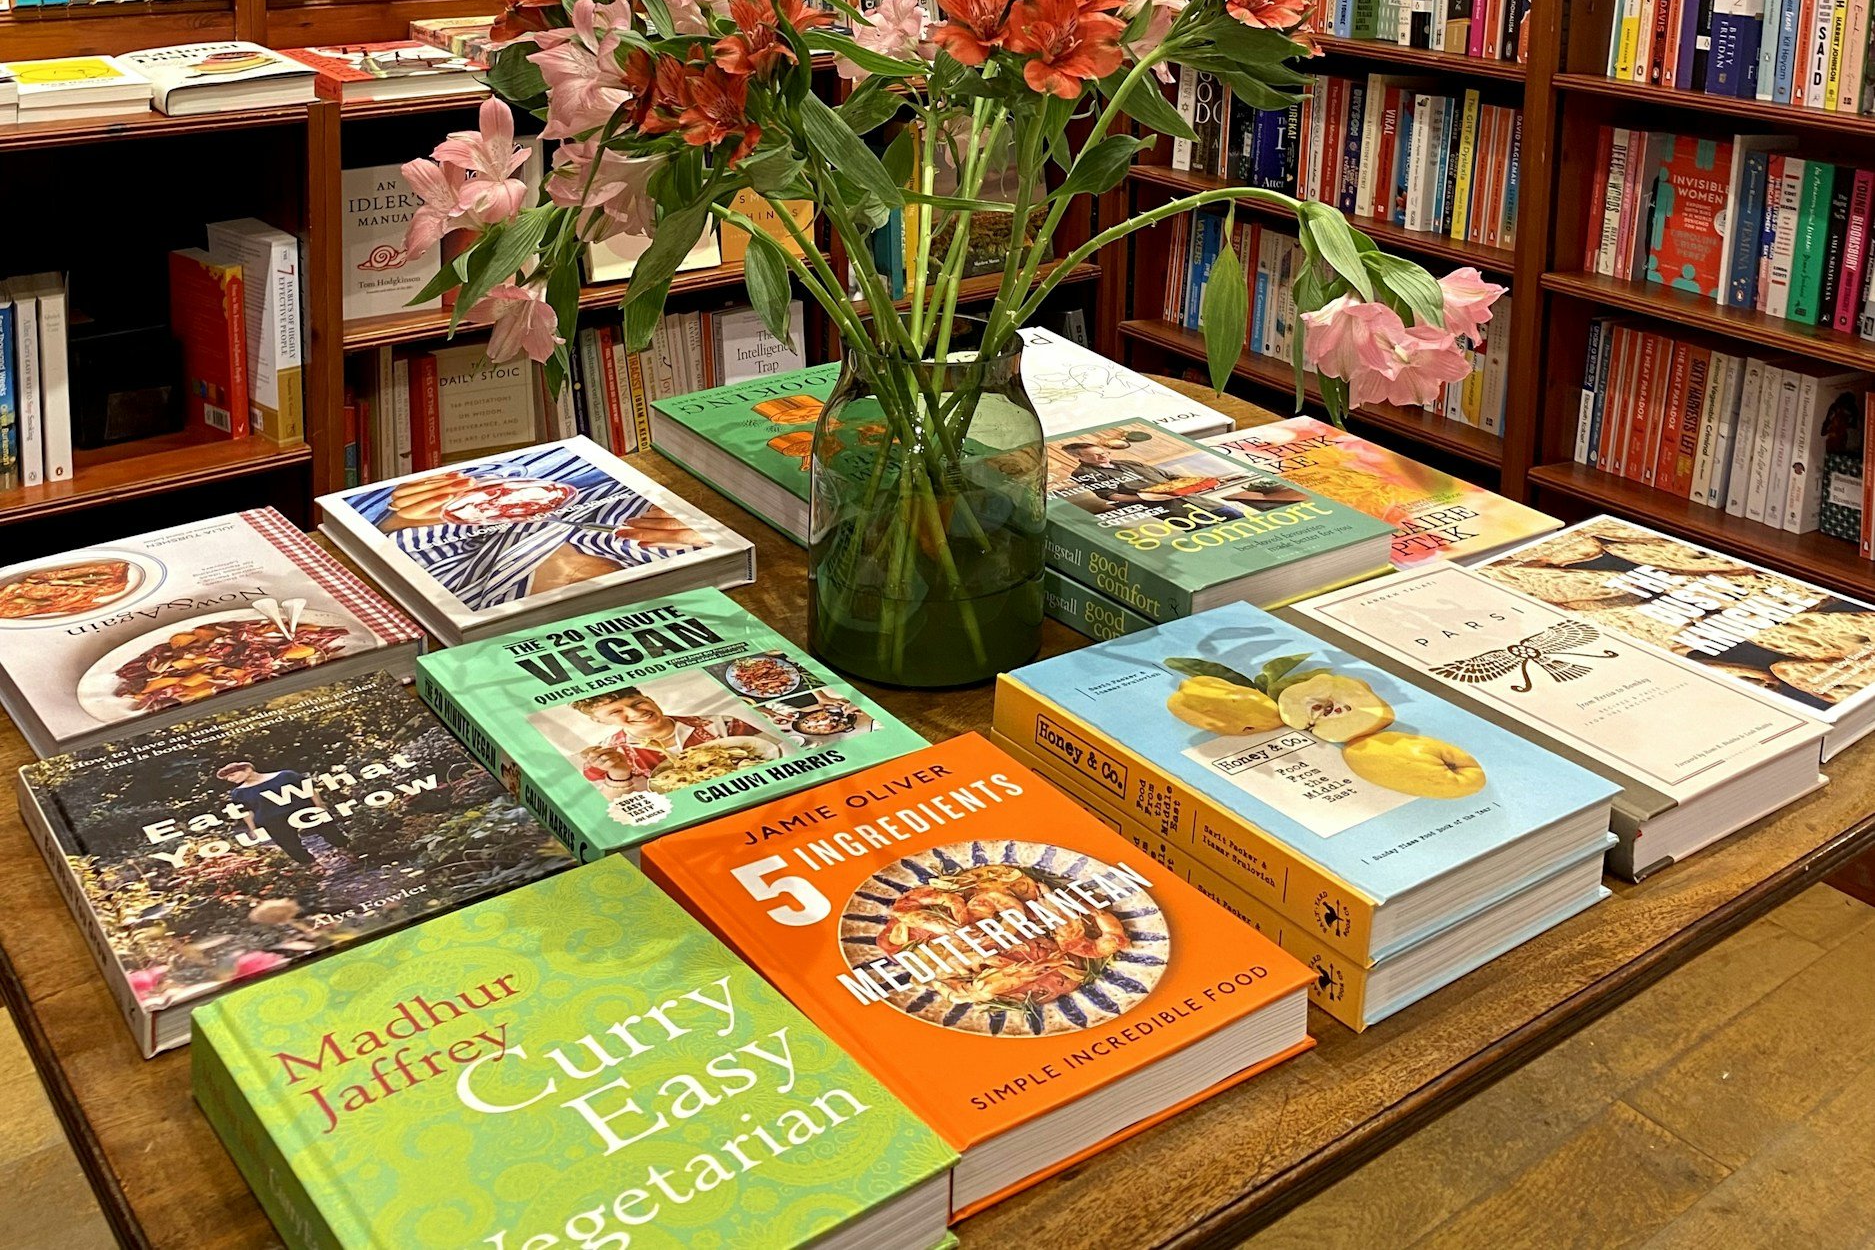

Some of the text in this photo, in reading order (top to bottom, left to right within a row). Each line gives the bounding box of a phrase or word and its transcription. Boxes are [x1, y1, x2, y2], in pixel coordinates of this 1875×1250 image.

[1813, 27, 1827, 85] SAID
[349, 192, 425, 213] IDLER'S
[376, 181, 397, 191] AN
[1673, 175, 1730, 193] INVISIBLE
[1678, 188, 1724, 204] WOMEN
[439, 367, 521, 388] DAILY STOIC
[755, 360, 779, 374] Trap
[1260, 435, 1342, 459] PINK
[1095, 503, 1149, 521] RIVER
[1098, 506, 1170, 529] COTTAGE
[1114, 504, 1228, 551] good
[1171, 502, 1333, 553] comfort
[1391, 527, 1480, 556] PTAK
[1088, 551, 1129, 583] good
[1603, 565, 1687, 599] THE
[1097, 573, 1160, 618] comfort
[503, 605, 686, 657] THE 20 MINUTE
[1415, 605, 1525, 649] PARSI
[1667, 584, 1821, 657] KNUCKLE
[513, 617, 728, 687] VEGAN
[533, 663, 668, 705] QUICK, EASY FOOD
[69, 681, 378, 772] How to have an undemanding edible garden
[102, 695, 359, 771] that is both beautiful and productive
[425, 680, 496, 769] THE 20 MINUTE VEGAN
[693, 750, 846, 804] CALUM HARRIS
[1039, 720, 1123, 790] Honey & Co.
[1219, 736, 1308, 772] Honey & Co.
[1275, 761, 1310, 776] Food
[1289, 768, 1322, 783] From
[141, 753, 422, 848] Eat What
[742, 762, 954, 848] JAMIE OLIVER
[1136, 779, 1146, 811] Food
[1146, 784, 1155, 817] From
[1155, 793, 1163, 817] the
[1302, 778, 1352, 800] Middle
[1305, 776, 1329, 788] the
[1328, 788, 1358, 802] East
[152, 771, 440, 871] You Grow
[525, 784, 576, 852] CALUM HARRIS
[1161, 785, 1172, 836] Middle
[1171, 800, 1181, 833] East
[729, 772, 1025, 928] 5 INGREDIENTS
[1202, 835, 1276, 887] Itamar Srulovich
[1203, 825, 1267, 870] Sarit Packer &
[309, 881, 429, 931] Alys Fowler
[835, 861, 1156, 1009] MEDITERRANEAN
[269, 970, 522, 1086] Madhur
[454, 974, 736, 1116] Curry
[968, 963, 1271, 1113] SIMPLE INCREDIBLE FOOD
[300, 1020, 511, 1134] Jaffrey
[558, 1025, 799, 1158] Easy
[481, 1080, 874, 1250] egetarian
